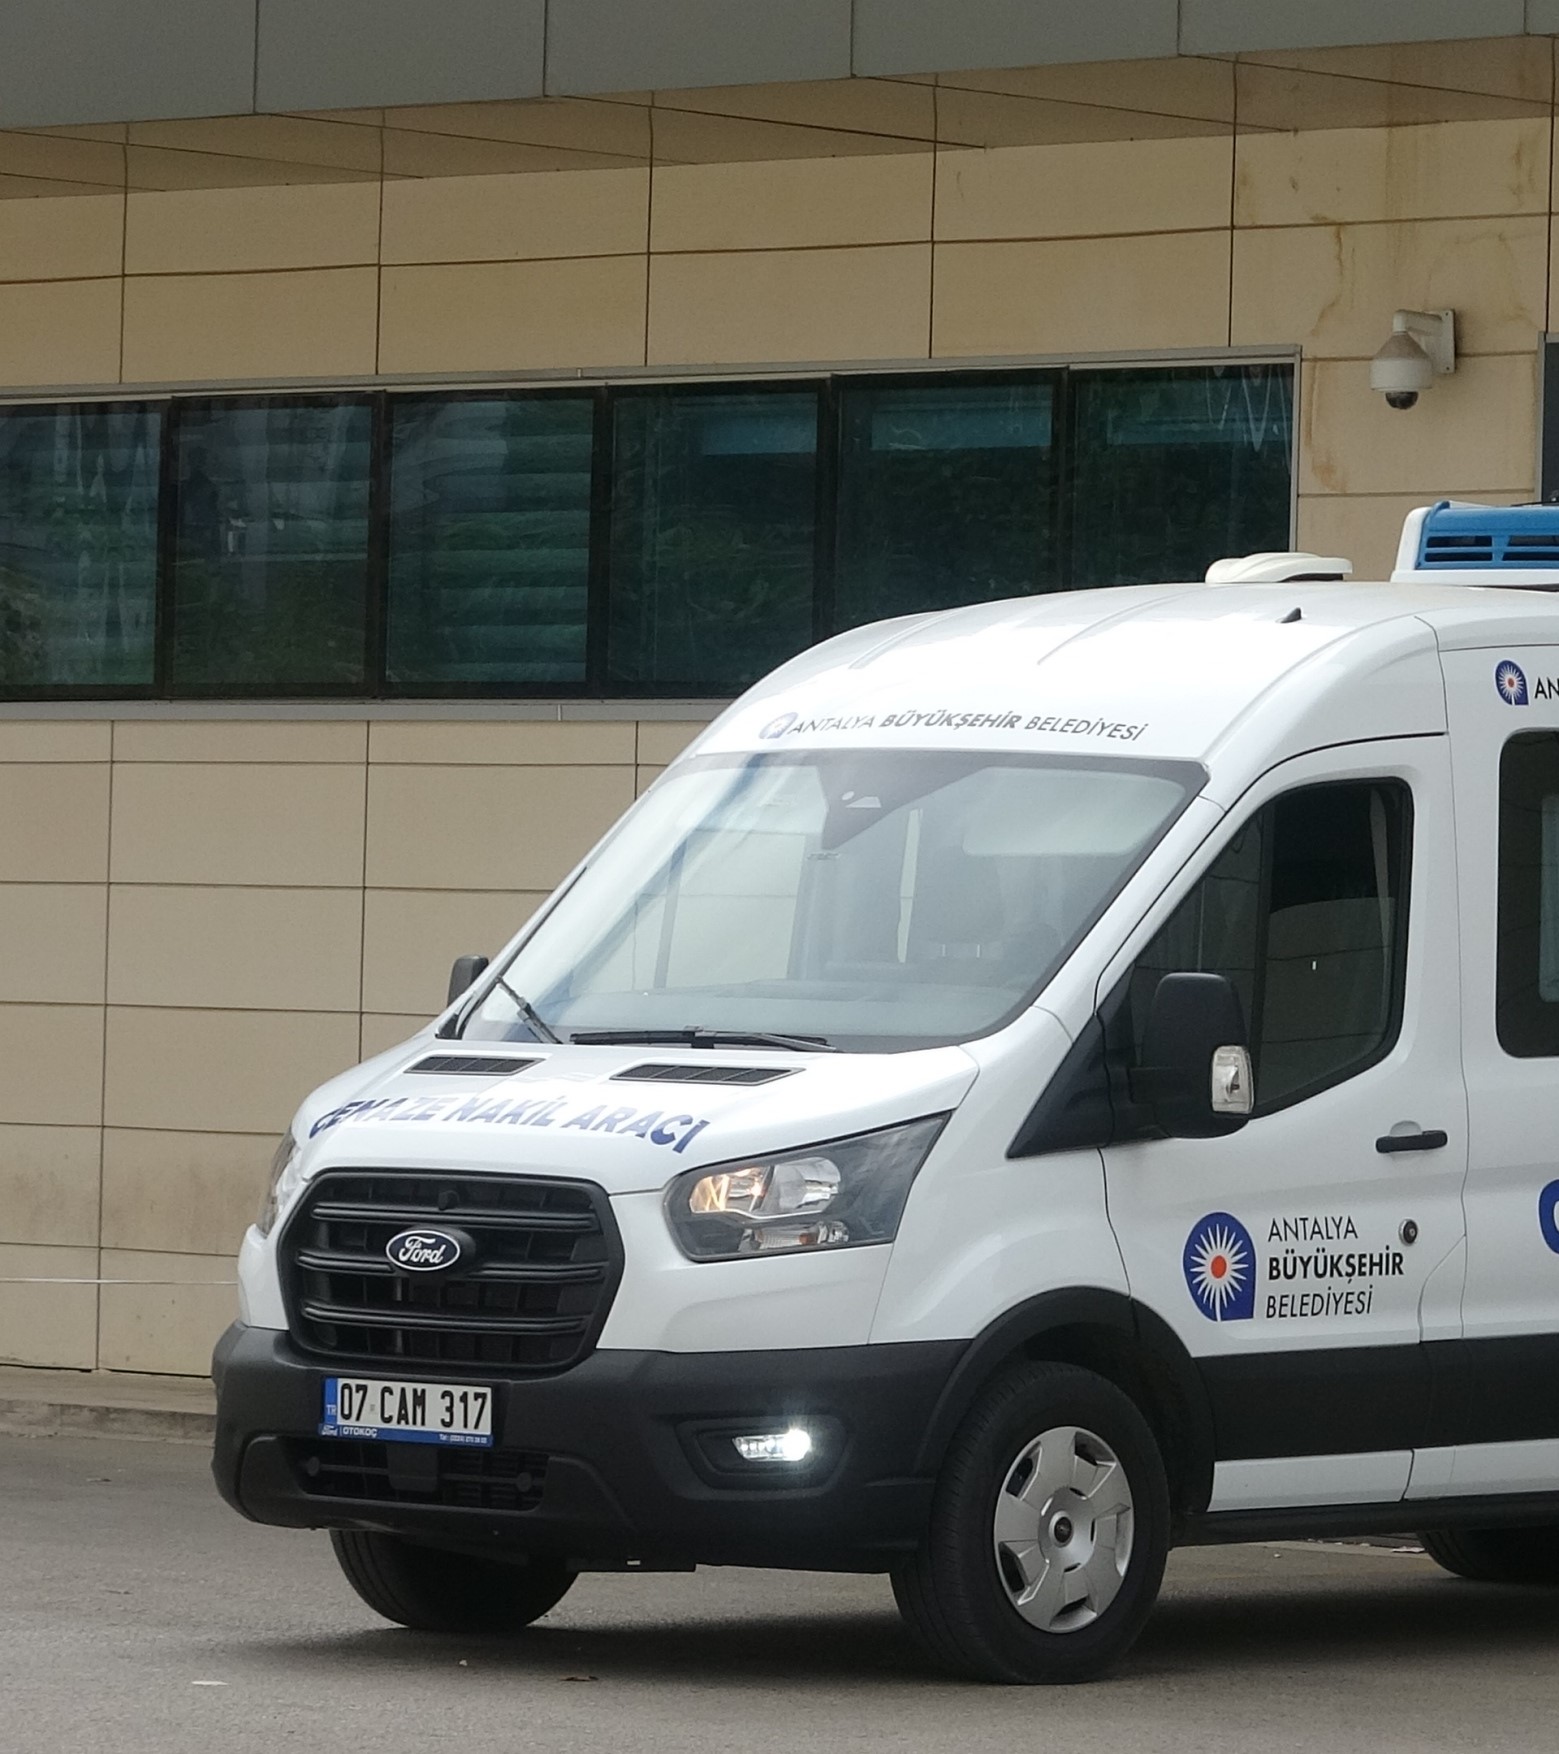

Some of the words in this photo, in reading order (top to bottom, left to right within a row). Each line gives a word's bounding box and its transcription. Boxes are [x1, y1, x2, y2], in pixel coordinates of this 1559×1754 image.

[789, 714, 875, 734] ANTALYA
[879, 709, 1021, 731] BÜYÜKŞEHİR
[1025, 716, 1147, 742] BELEDİYESİ
[309, 1096, 448, 1139] CENAZE
[443, 1095, 559, 1128] NAKİL
[560, 1103, 711, 1154] ARACI
[1267, 1215, 1358, 1242] ANTALYA
[397, 1235, 446, 1267] Ford
[1268, 1245, 1404, 1284] BÜYÜKŞEHİR
[1266, 1284, 1373, 1319] BELEDİYESİ
[326, 1404, 336, 1416] TR
[340, 1383, 368, 1422] 07
[380, 1386, 426, 1427] CAM
[440, 1390, 488, 1430] 317
[343, 1427, 378, 1438] OTOKOÇ
